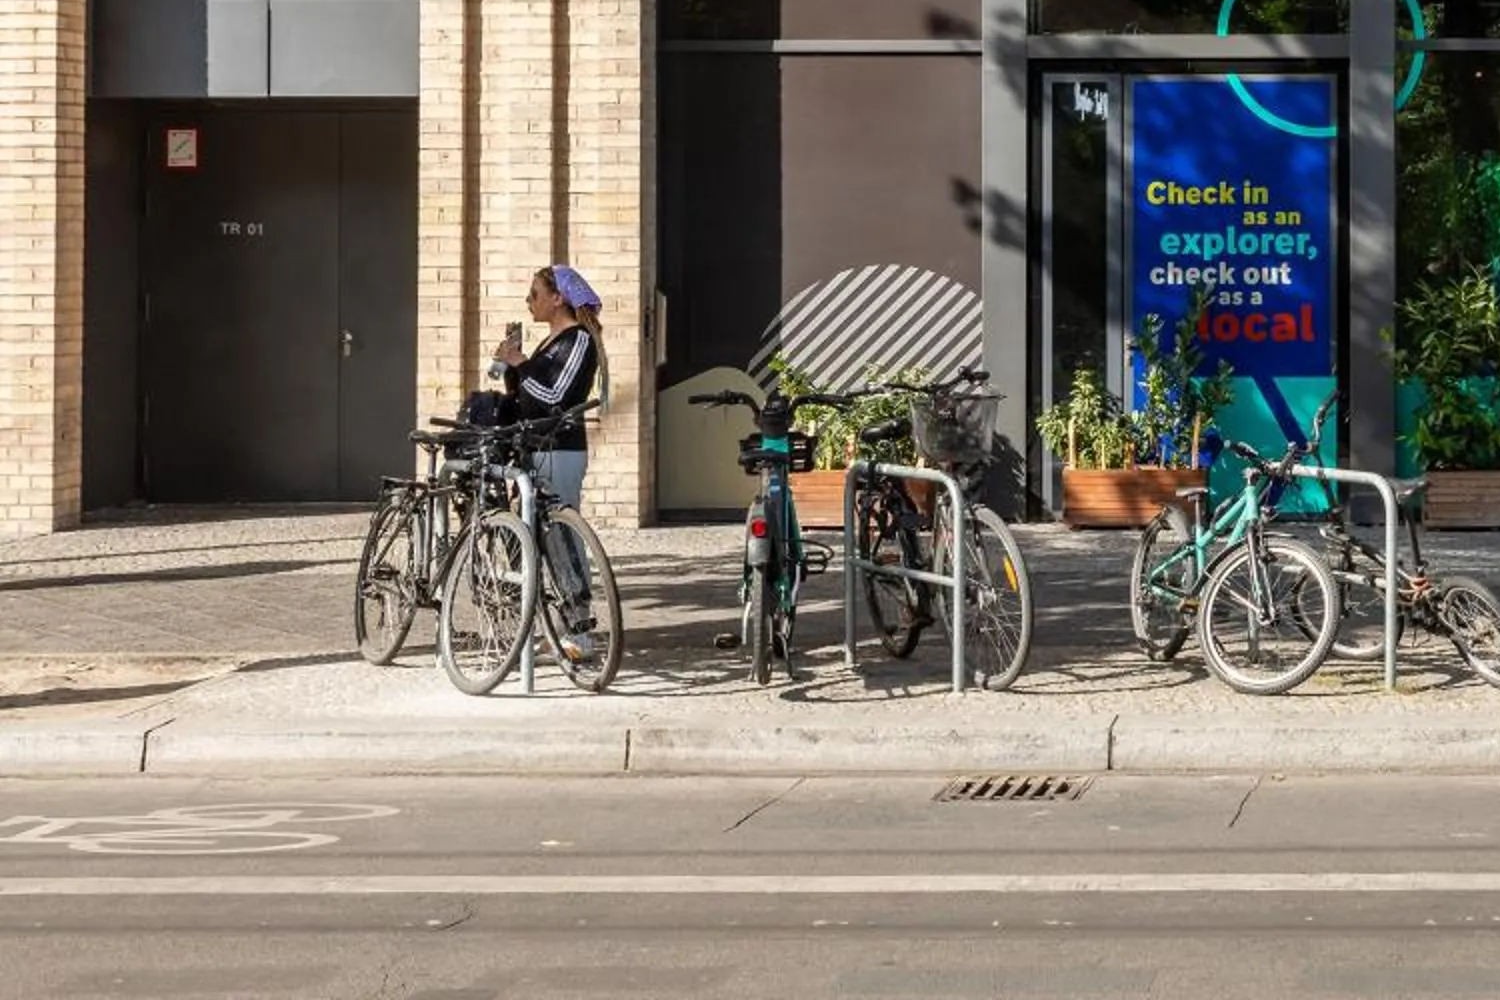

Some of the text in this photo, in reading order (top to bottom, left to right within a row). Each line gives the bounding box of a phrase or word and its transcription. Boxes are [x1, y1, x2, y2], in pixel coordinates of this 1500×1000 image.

[1146, 180, 1269, 205] Check in
[220, 221, 263, 236] TR 01
[1243, 211, 1301, 225] as an
[1160, 226, 1318, 260] explorer,
[1150, 262, 1292, 285] check out
[1219, 291, 1263, 305] as a
[1197, 304, 1316, 342] local
